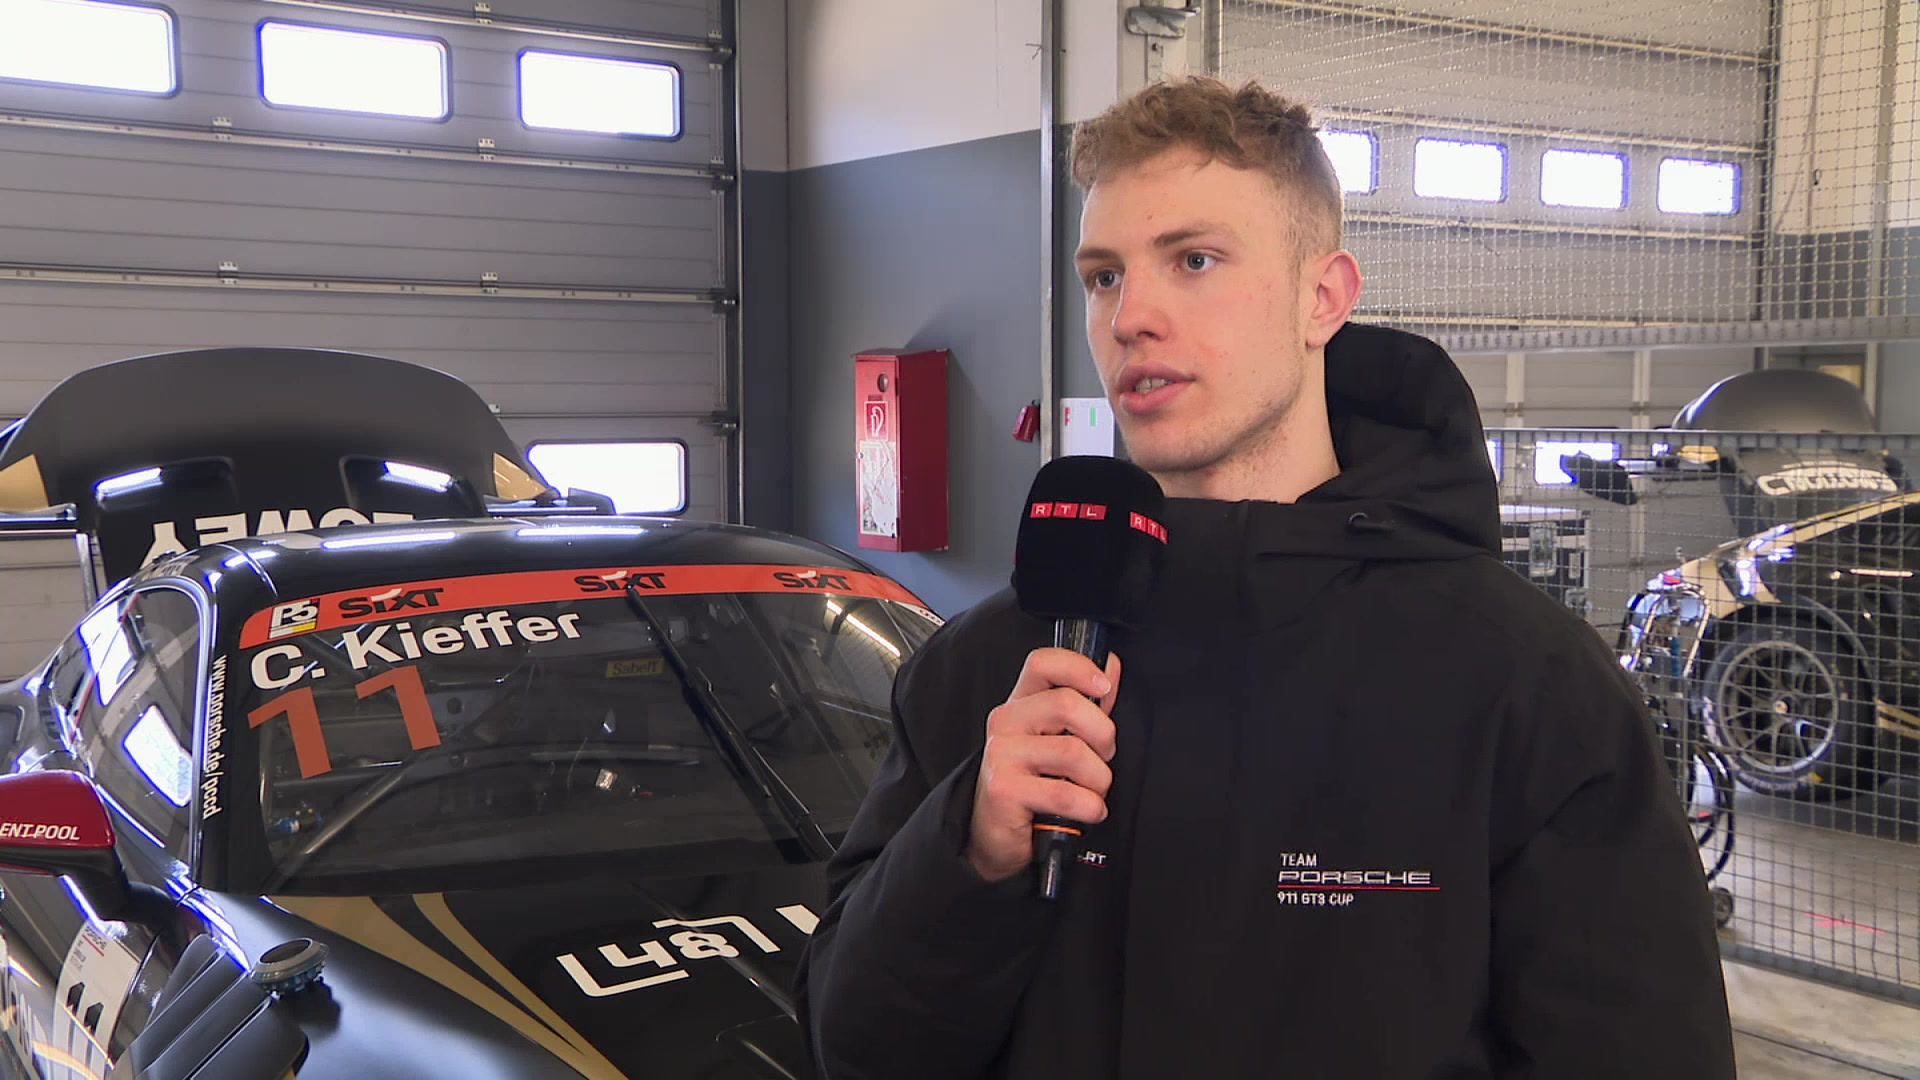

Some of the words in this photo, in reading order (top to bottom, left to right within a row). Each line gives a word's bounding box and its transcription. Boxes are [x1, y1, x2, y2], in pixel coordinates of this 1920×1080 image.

[1033, 504, 1101, 518] RTL
[251, 644, 327, 691] C.
[343, 610, 582, 670] Kieffer
[247, 664, 441, 780] 11
[1280, 853, 1317, 867] TEAM
[1278, 871, 1431, 884] PORSCHE
[1277, 891, 1298, 905] 911
[1329, 893, 1354, 907] CUP
